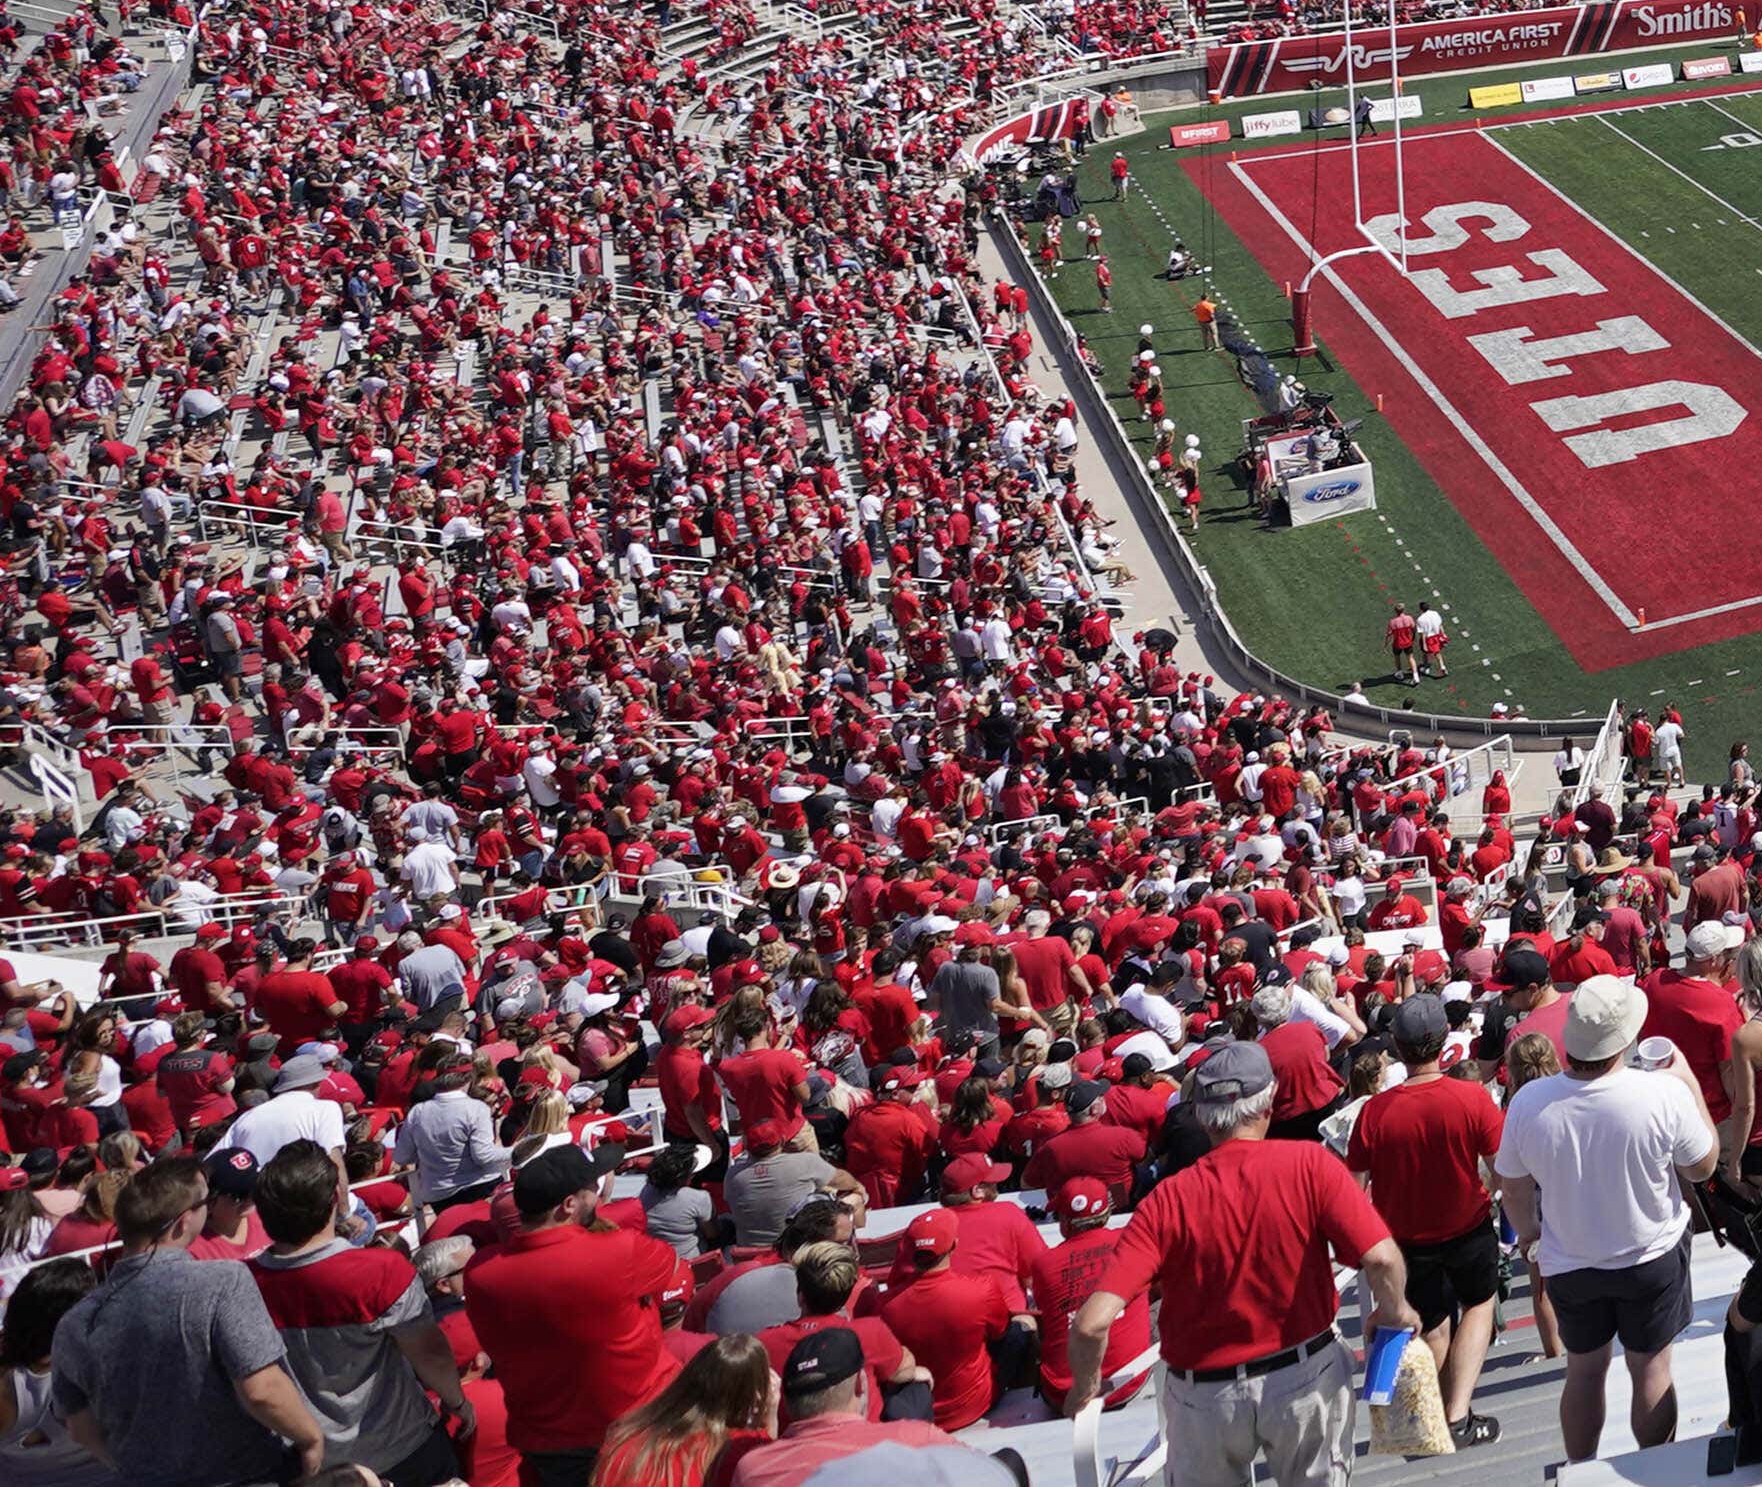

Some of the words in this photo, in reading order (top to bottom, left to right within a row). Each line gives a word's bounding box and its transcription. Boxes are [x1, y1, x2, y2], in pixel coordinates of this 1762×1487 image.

[1637, 2, 1734, 37] Smith's
[1420, 30, 1505, 51] AMERICA
[1508, 22, 1563, 44] FIRST
[1435, 45, 1488, 59] CREDIT
[1497, 39, 1551, 54] UNION
[1366, 201, 1750, 470] UTES
[1313, 484, 1352, 501] Ford
[1224, 983, 1243, 1005] 11
